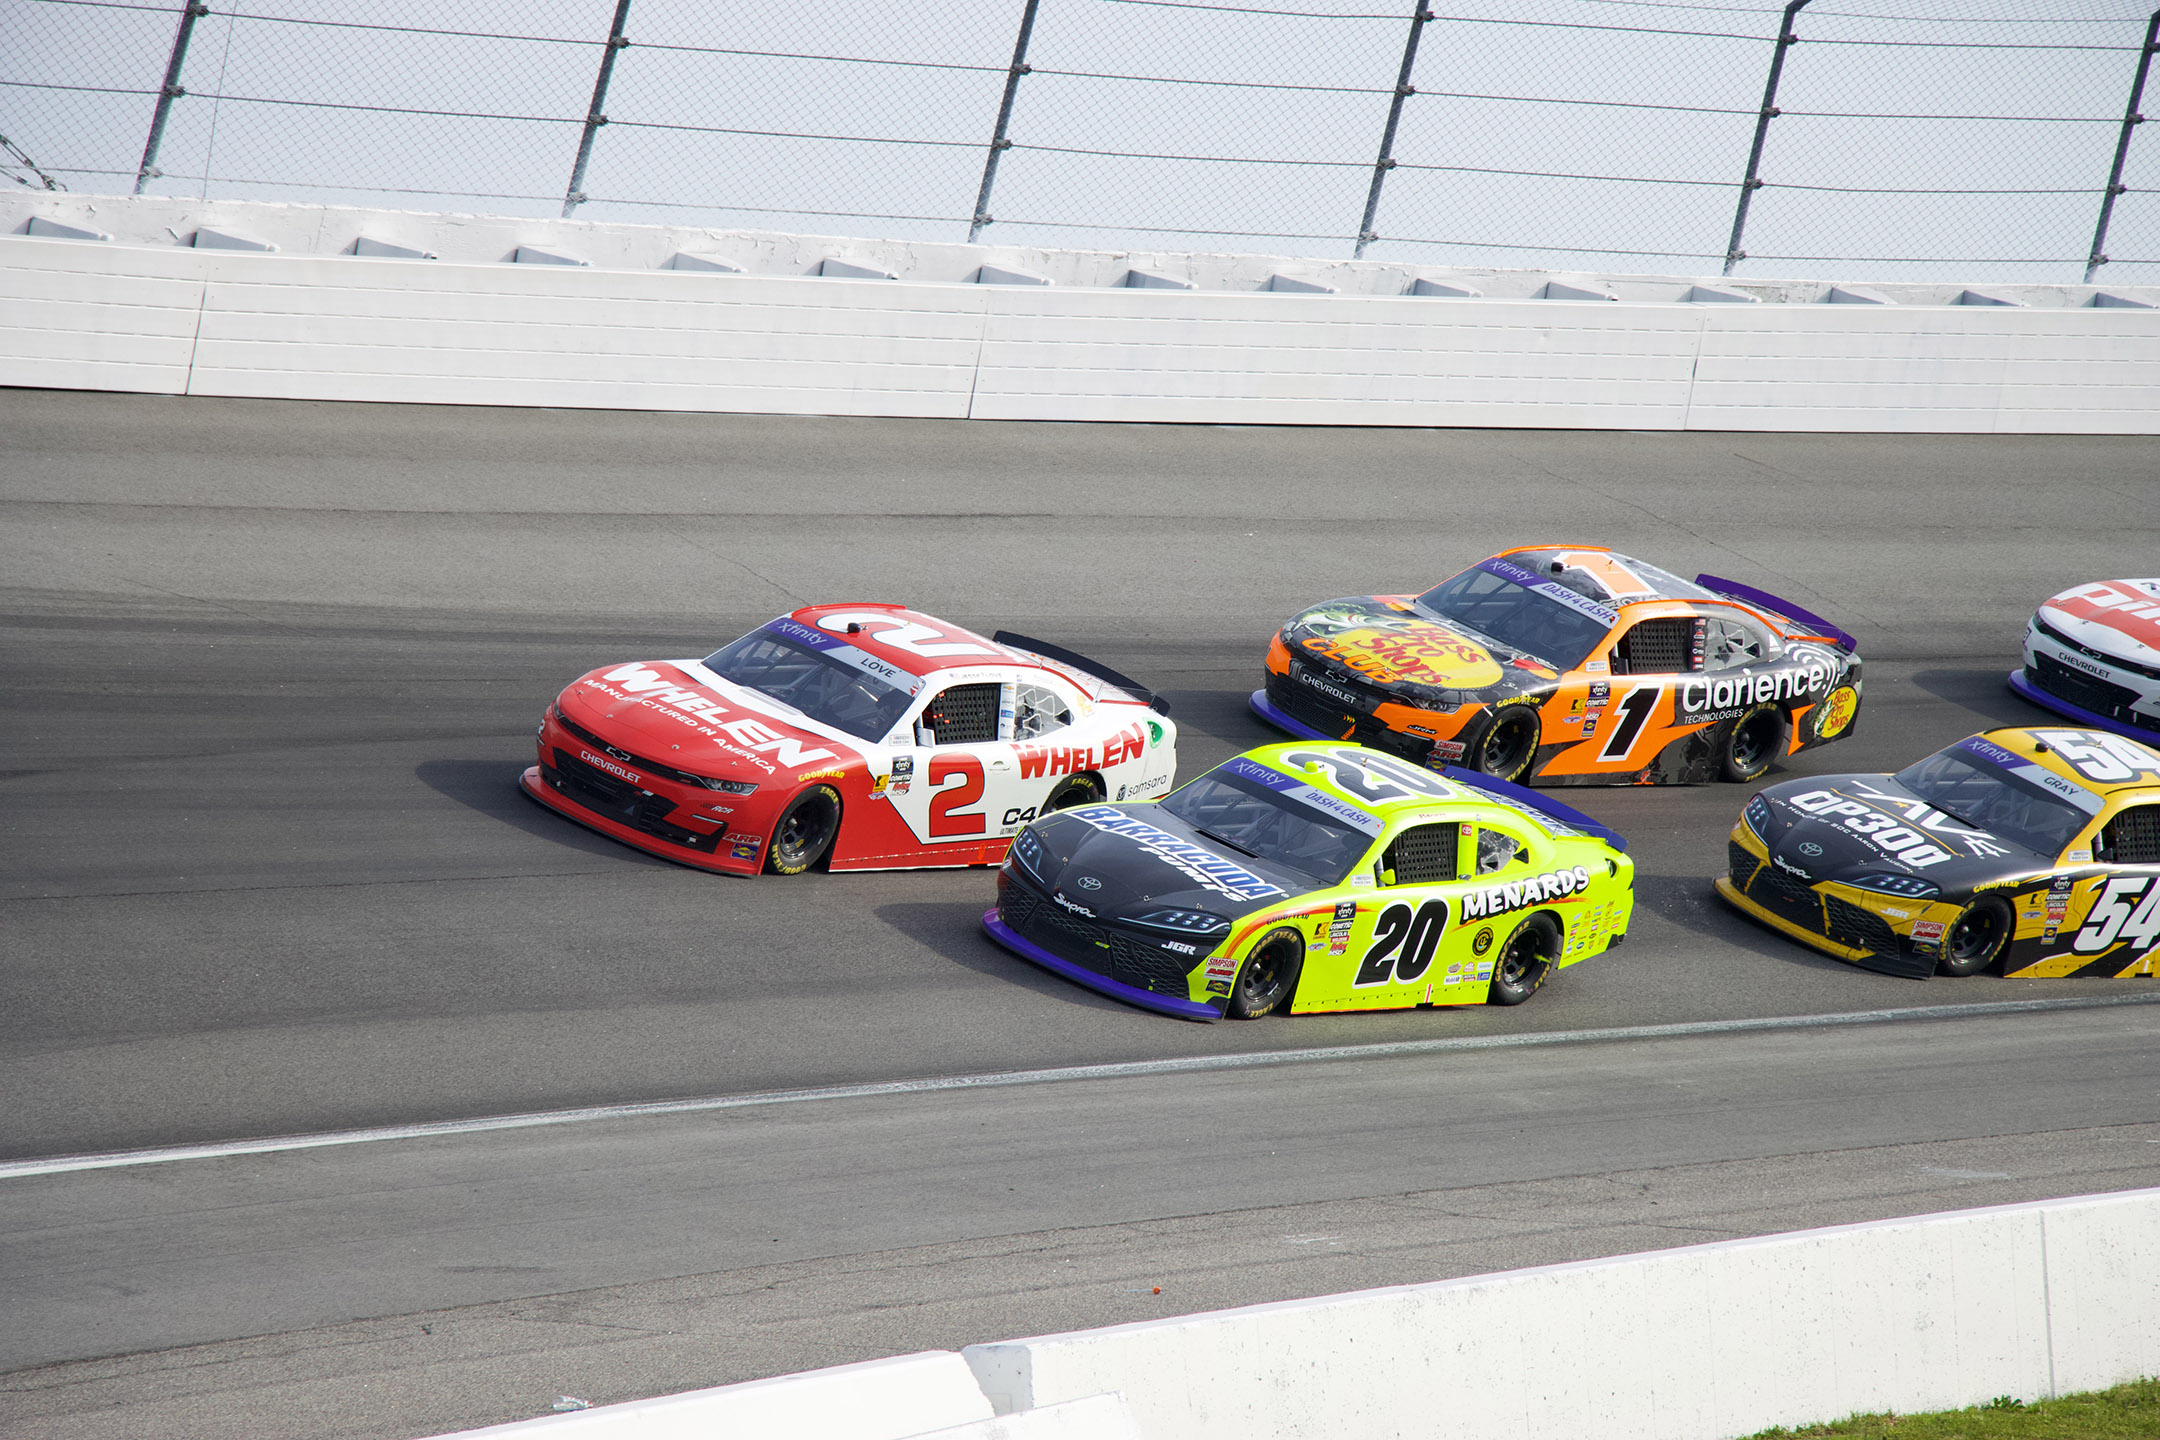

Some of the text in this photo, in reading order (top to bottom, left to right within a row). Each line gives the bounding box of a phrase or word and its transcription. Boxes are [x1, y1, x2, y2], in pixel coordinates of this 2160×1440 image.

[1490, 558, 1535, 583] xfinity
[1541, 581, 1576, 600] DASH
[1578, 598, 1613, 621] CASH
[778, 620, 828, 646] xfinity
[1380, 632, 1445, 658] Pro
[1404, 626, 1487, 664] Bass
[861, 657, 898, 679] LOVE
[1301, 638, 1404, 684] CLUB
[1352, 637, 1452, 684] Shops
[2058, 651, 2111, 679] CHEVROLET
[1302, 673, 1357, 705] CHEVROLET
[1682, 663, 1825, 714] Clarience
[583, 678, 699, 728] MANUFACTURED
[697, 723, 717, 737] IN
[713, 737, 777, 775] AMERICA
[602, 662, 837, 768] WHELEN
[1596, 682, 1665, 763] 1
[1684, 708, 1744, 725] TECHNOLOGIES
[1408, 724, 1439, 735] JRM
[1009, 722, 1145, 780] WHELEN
[1429, 750, 1462, 759] ARP
[1436, 741, 1464, 752] SIMPSON
[1968, 740, 2015, 764] xfinity
[580, 750, 641, 783] CHEVROLET
[798, 769, 846, 782] GOODYEAR
[1234, 761, 1286, 785] xfinity
[928, 752, 986, 838] 2
[1071, 778, 1094, 789] EAGLE
[1127, 773, 1168, 798] samsara
[2043, 776, 2080, 796] GRAY
[710, 804, 735, 816] RCR
[1002, 806, 1038, 826] C4
[1305, 790, 1338, 809] DASH
[1340, 807, 1372, 826] CASH
[725, 833, 761, 845] ARP
[1064, 806, 1286, 900] BARRACUDA
[1773, 854, 1812, 879] Supra
[1459, 865, 1590, 925] MENARDS
[1973, 879, 2020, 894] GOODYEAR
[1053, 892, 1097, 919] Supra
[1880, 907, 1910, 919] JGR
[2073, 876, 2160, 952] 54
[1912, 930, 1941, 939] ARP
[1914, 920, 1945, 932] SIMPSON
[1161, 940, 1197, 956] JGR
[1352, 895, 1450, 989] 20
[1206, 968, 1235, 977] ARP
[1208, 957, 1238, 968] SIMPSON
